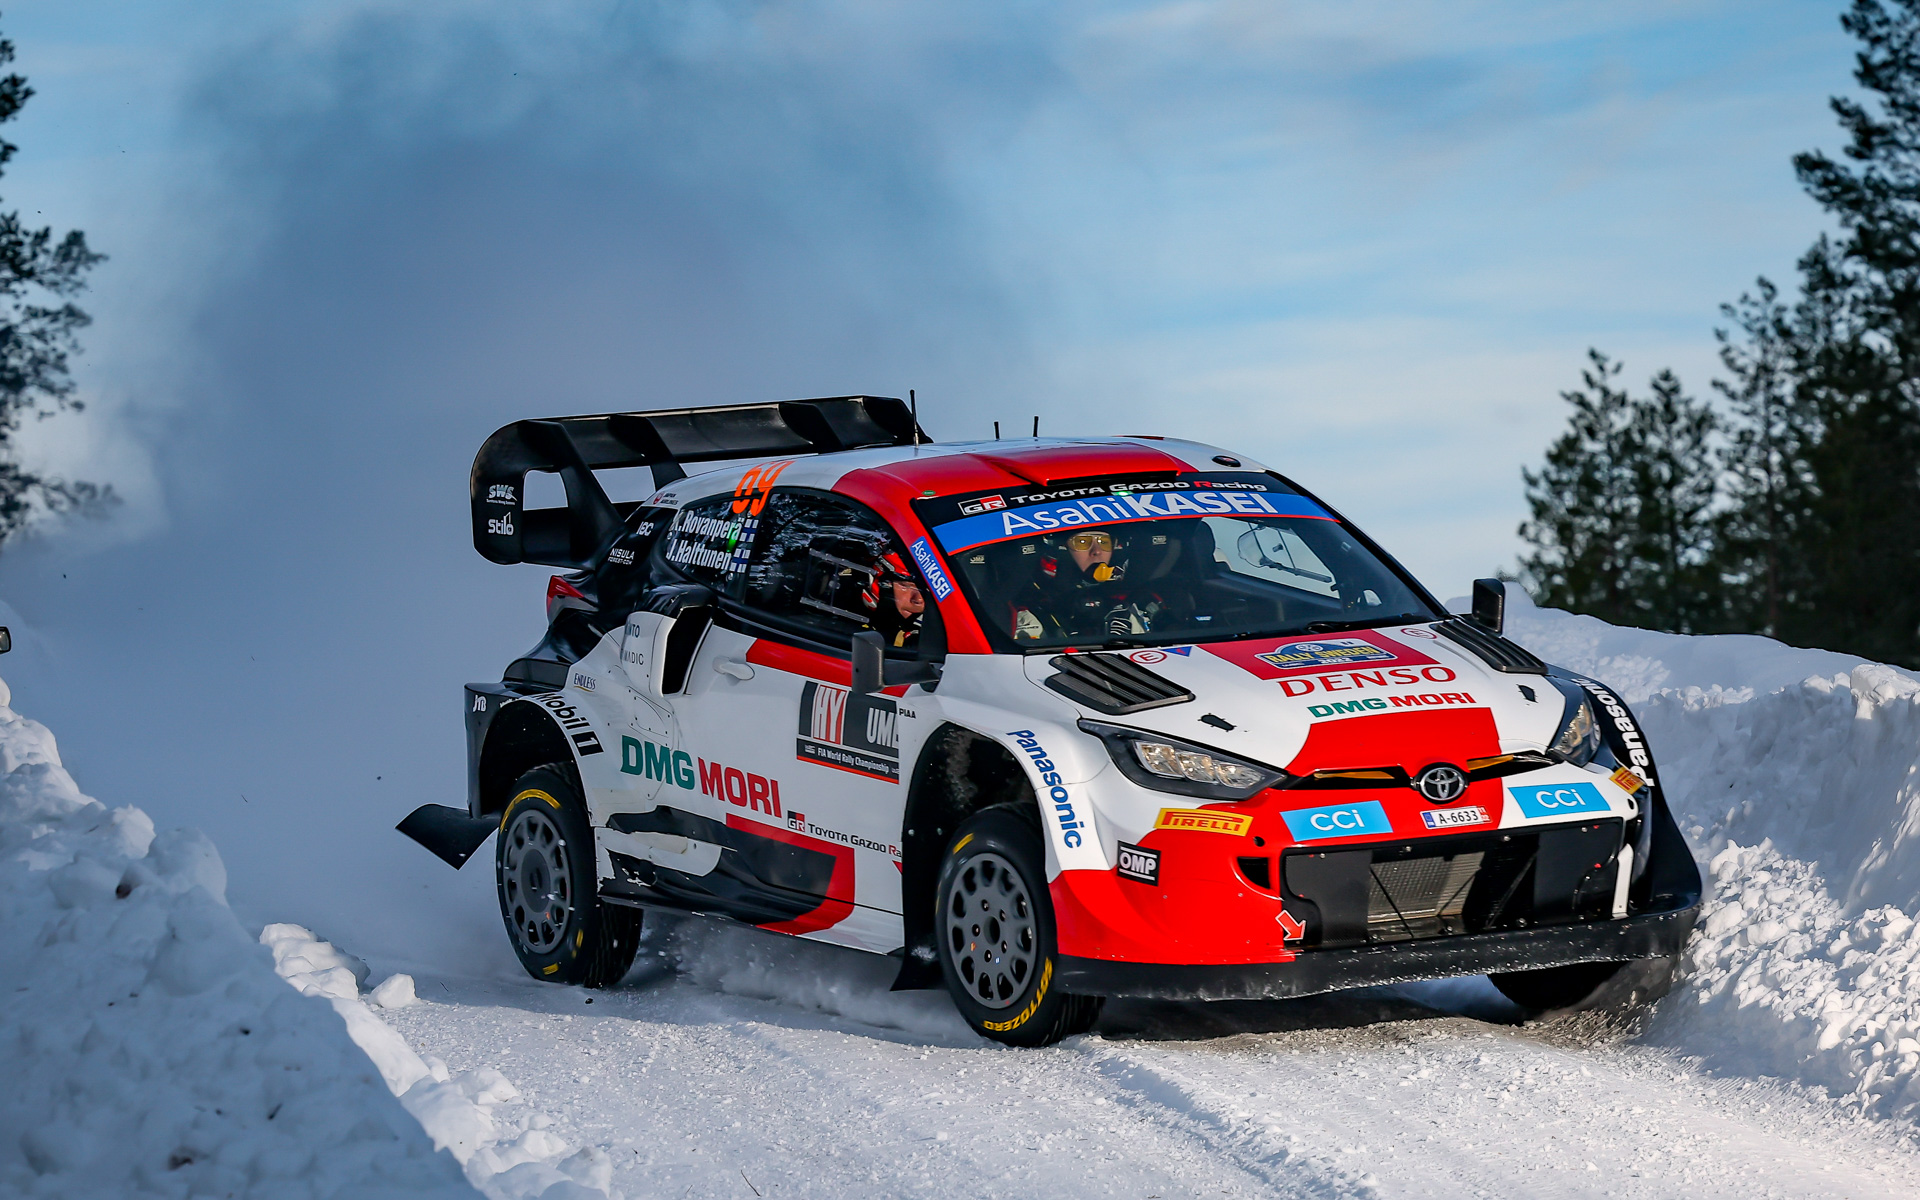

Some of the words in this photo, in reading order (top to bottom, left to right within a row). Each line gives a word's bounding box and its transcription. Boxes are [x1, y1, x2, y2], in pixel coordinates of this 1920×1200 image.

[488, 484, 516, 500] SWS
[732, 461, 797, 516] 69
[1010, 486, 1105, 504] TOYOTA
[1108, 480, 1190, 492] GAZOO
[1193, 481, 1267, 491] Racing
[963, 499, 1004, 513] GR
[1003, 493, 1278, 536] AsahiKASEI
[488, 512, 514, 536] Stilo
[610, 548, 635, 559] NISULA
[911, 540, 951, 599] AsahiKASEI
[1265, 651, 1314, 663] RALLY
[1315, 646, 1379, 659] SWEDEN
[573, 673, 597, 690] ENDLESS
[1276, 666, 1457, 697] DENSO
[530, 692, 591, 730] Mobil
[813, 685, 846, 743] HY
[899, 708, 916, 719] PIAA
[1306, 697, 1387, 718] DMG
[1388, 692, 1477, 707] MORI
[1571, 678, 1655, 787] Panasonic
[817, 747, 827, 757] FIA
[826, 749, 841, 763] World
[842, 753, 854, 766] Rally
[855, 756, 889, 774] Championship
[620, 734, 695, 790] DMG
[698, 756, 782, 819] MORI
[1006, 729, 1085, 849] Panasonic
[1161, 811, 1244, 832] PIRELLI
[1438, 810, 1479, 826] A-6633
[788, 818, 805, 832] GR
[808, 823, 848, 843] TOYOTA
[850, 834, 886, 853] GAZOO
[1119, 852, 1157, 875] OMP
